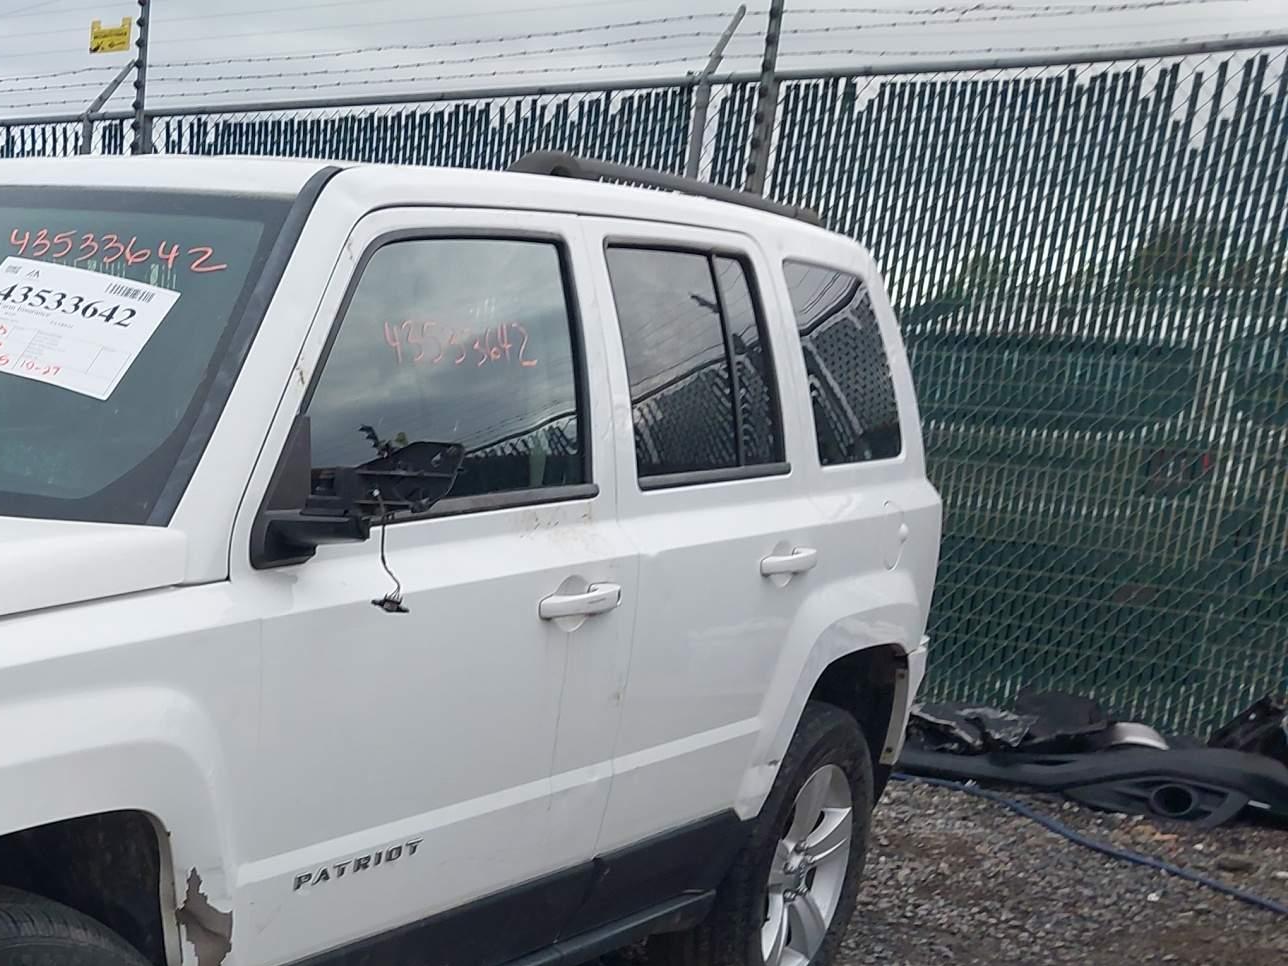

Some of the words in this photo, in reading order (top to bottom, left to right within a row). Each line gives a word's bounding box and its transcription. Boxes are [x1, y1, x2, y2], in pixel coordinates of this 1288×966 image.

[9, 227, 228, 273] 43533642
[20, 359, 62, 376] 10-27
[292, 836, 425, 891] PATRIOT
